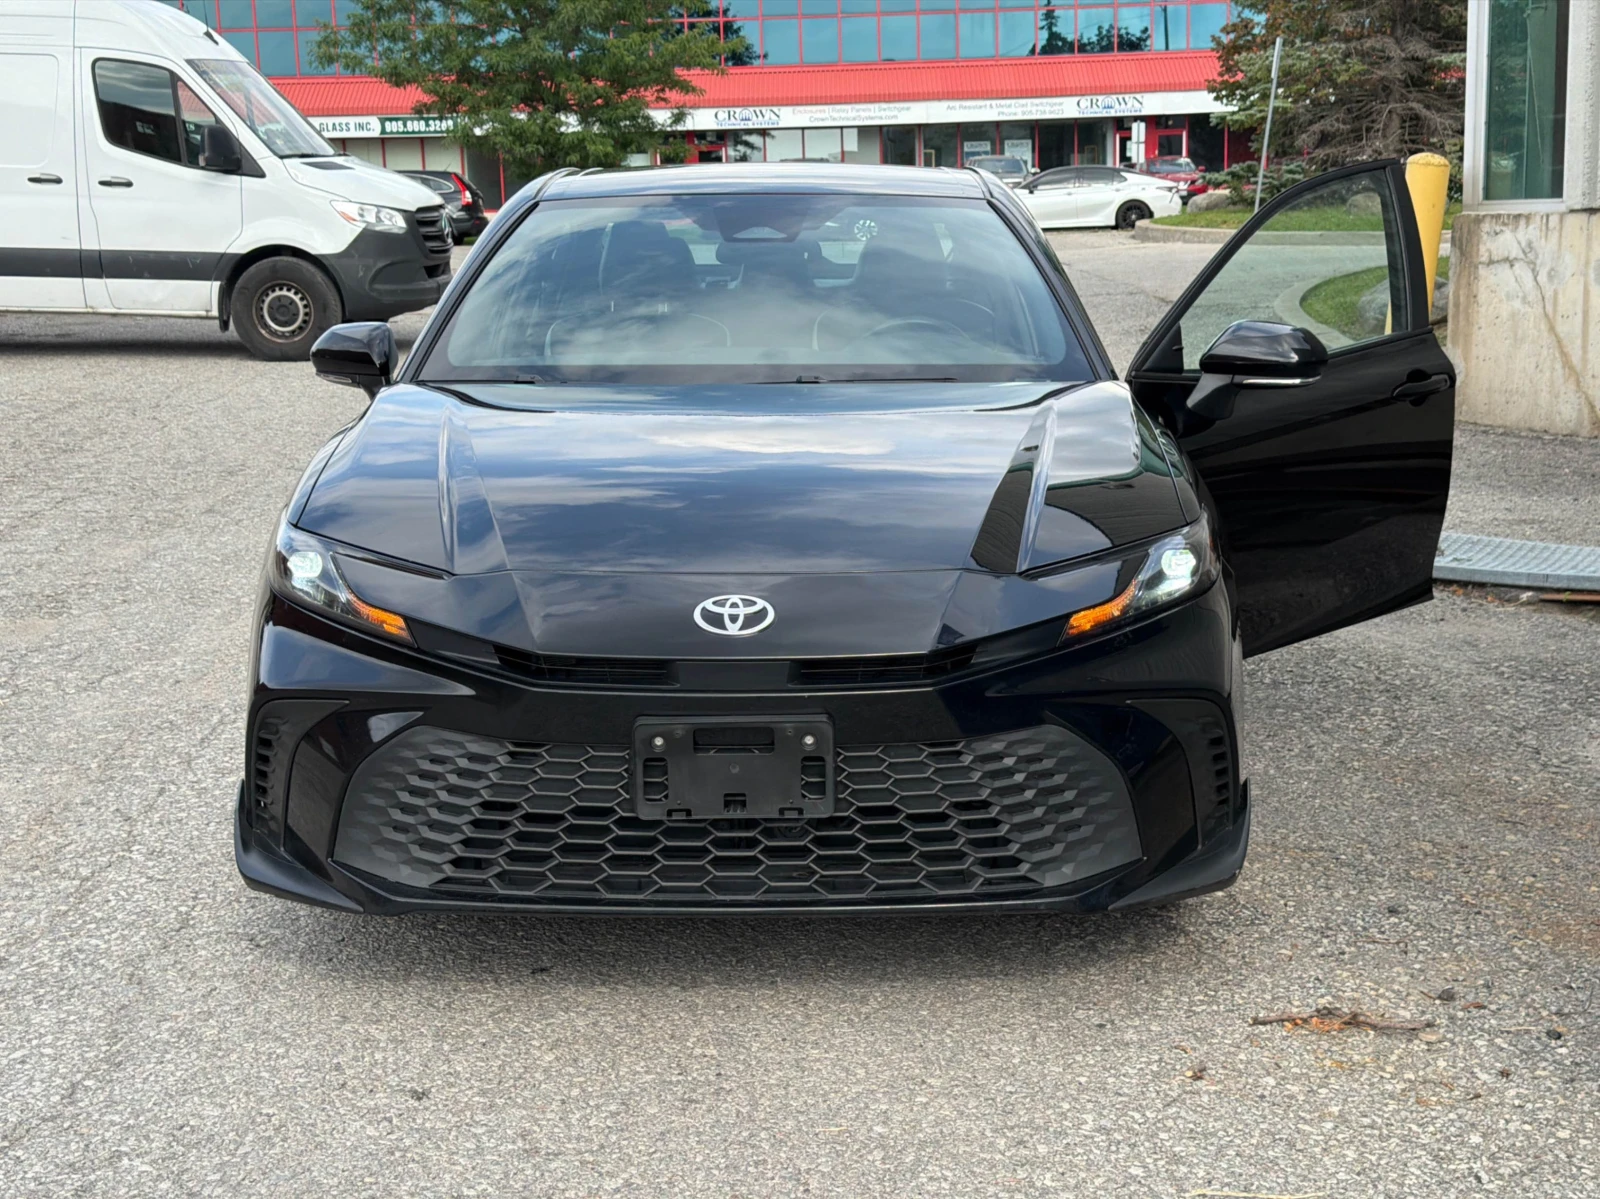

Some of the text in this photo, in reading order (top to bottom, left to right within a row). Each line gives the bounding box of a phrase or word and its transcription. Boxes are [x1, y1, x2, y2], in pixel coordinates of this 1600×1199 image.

[995, 101, 1013, 109] Metal
[1077, 95, 1144, 109] CROWN
[714, 108, 781, 121] CROWN
[319, 121, 375, 132] GLASS INC.
